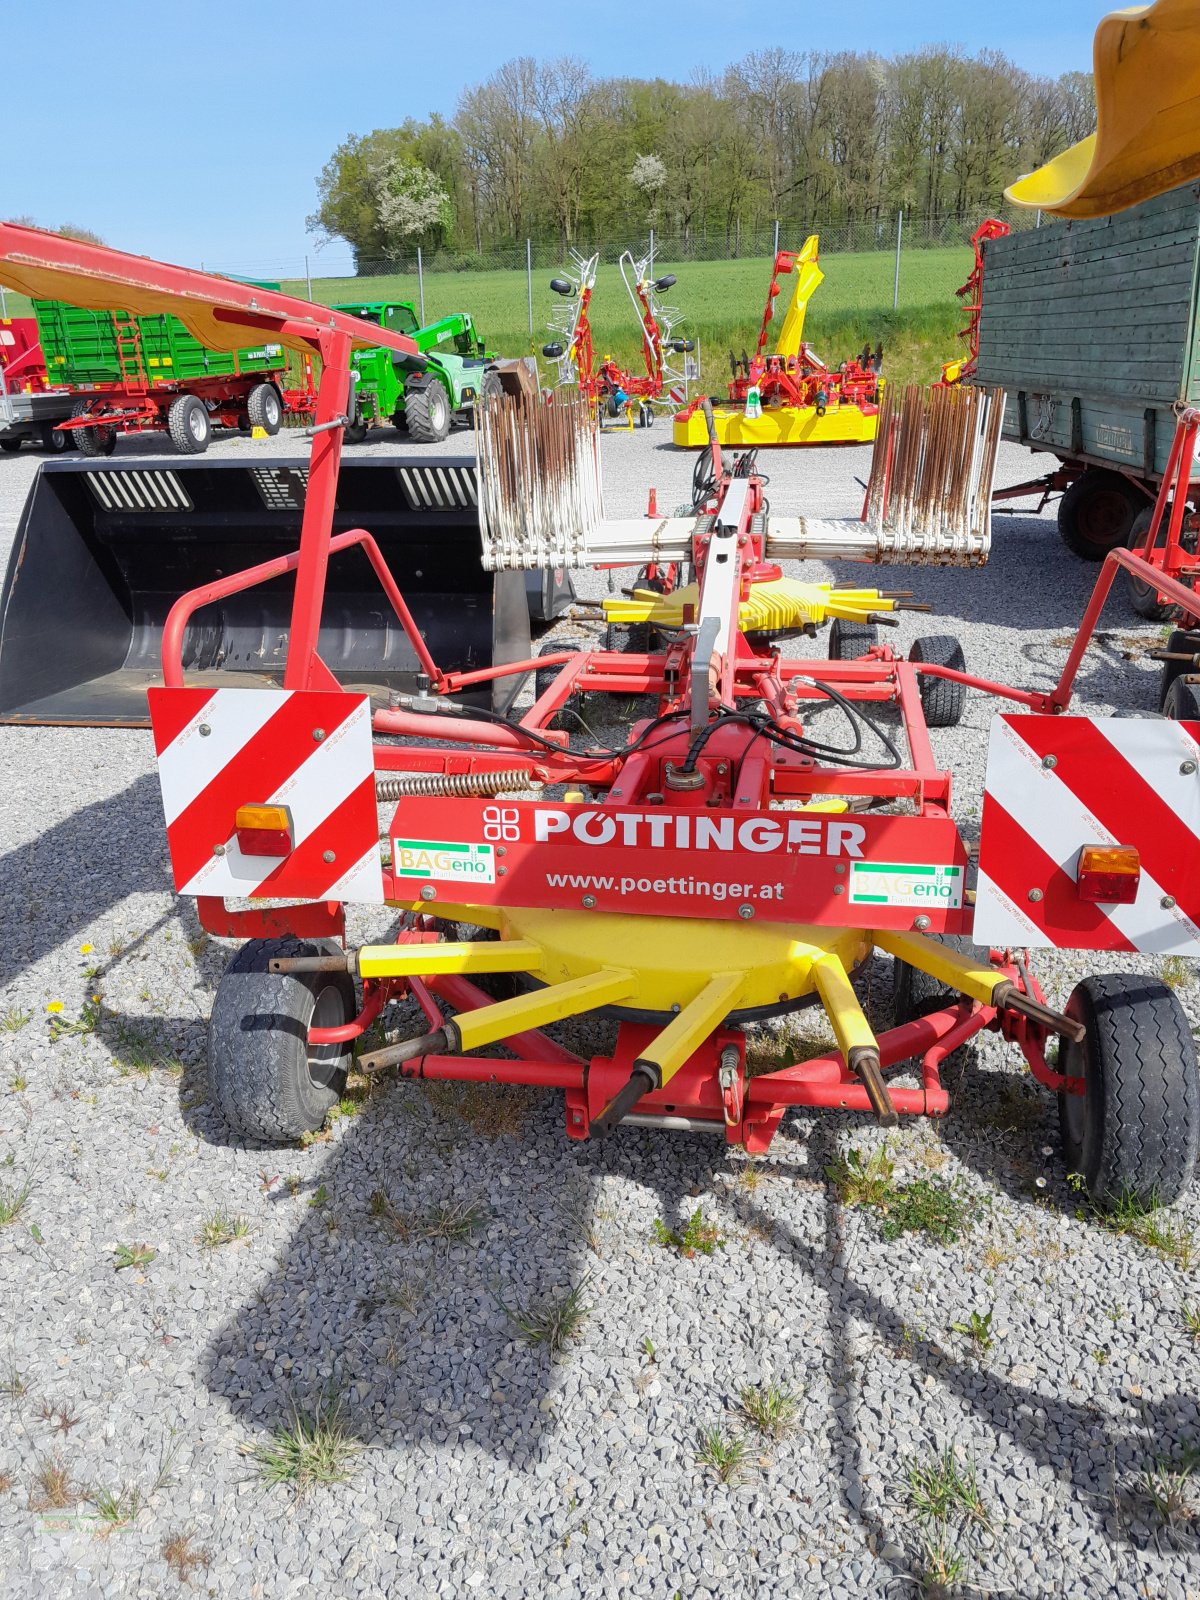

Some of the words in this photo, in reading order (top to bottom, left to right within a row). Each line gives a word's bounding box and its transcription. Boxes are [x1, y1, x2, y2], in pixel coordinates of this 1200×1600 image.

[534, 809, 867, 858] PÖTTINGER
[400, 848, 486, 873] BAGeno
[546, 873, 785, 901] www.poettinger.at
[854, 874, 953, 898] BAGeno
